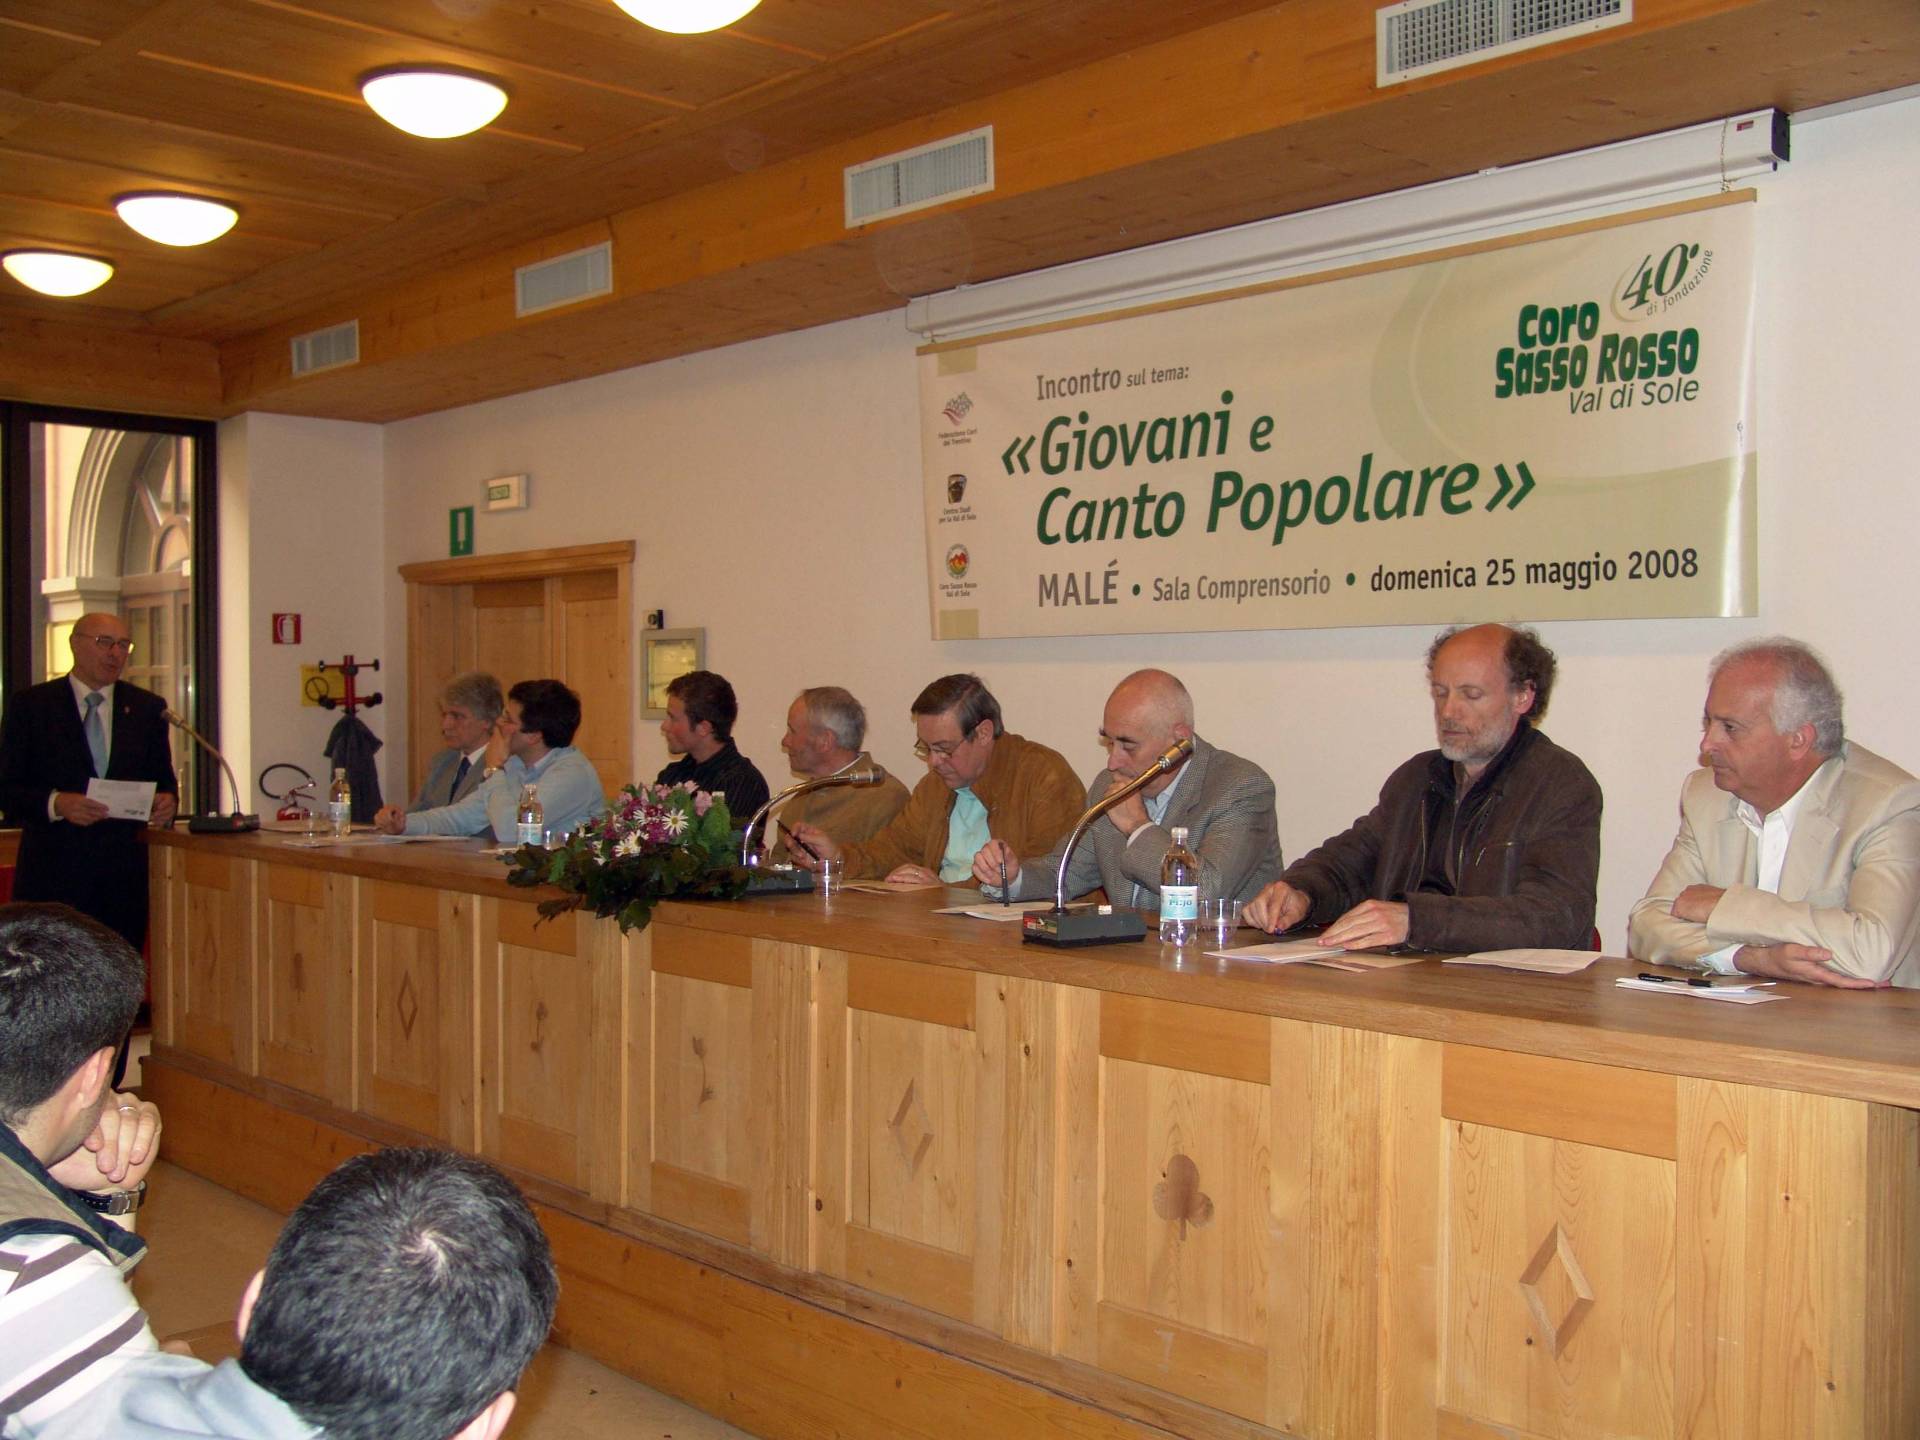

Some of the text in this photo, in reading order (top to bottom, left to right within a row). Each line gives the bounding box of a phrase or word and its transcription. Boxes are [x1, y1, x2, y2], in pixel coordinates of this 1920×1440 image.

[1645, 249, 1713, 316] di fondazione
[1518, 301, 1600, 350] Coro
[1596, 327, 1700, 385] Rosso
[1036, 366, 1190, 401] Incontro sul tema:
[1569, 377, 1700, 415] Val di Sole
[1249, 415, 1275, 452] e
[1036, 483, 1186, 546] Canto
[1038, 548, 1699, 608] MALÉ Sala Comprensorio domenica 25 maggio 2008
